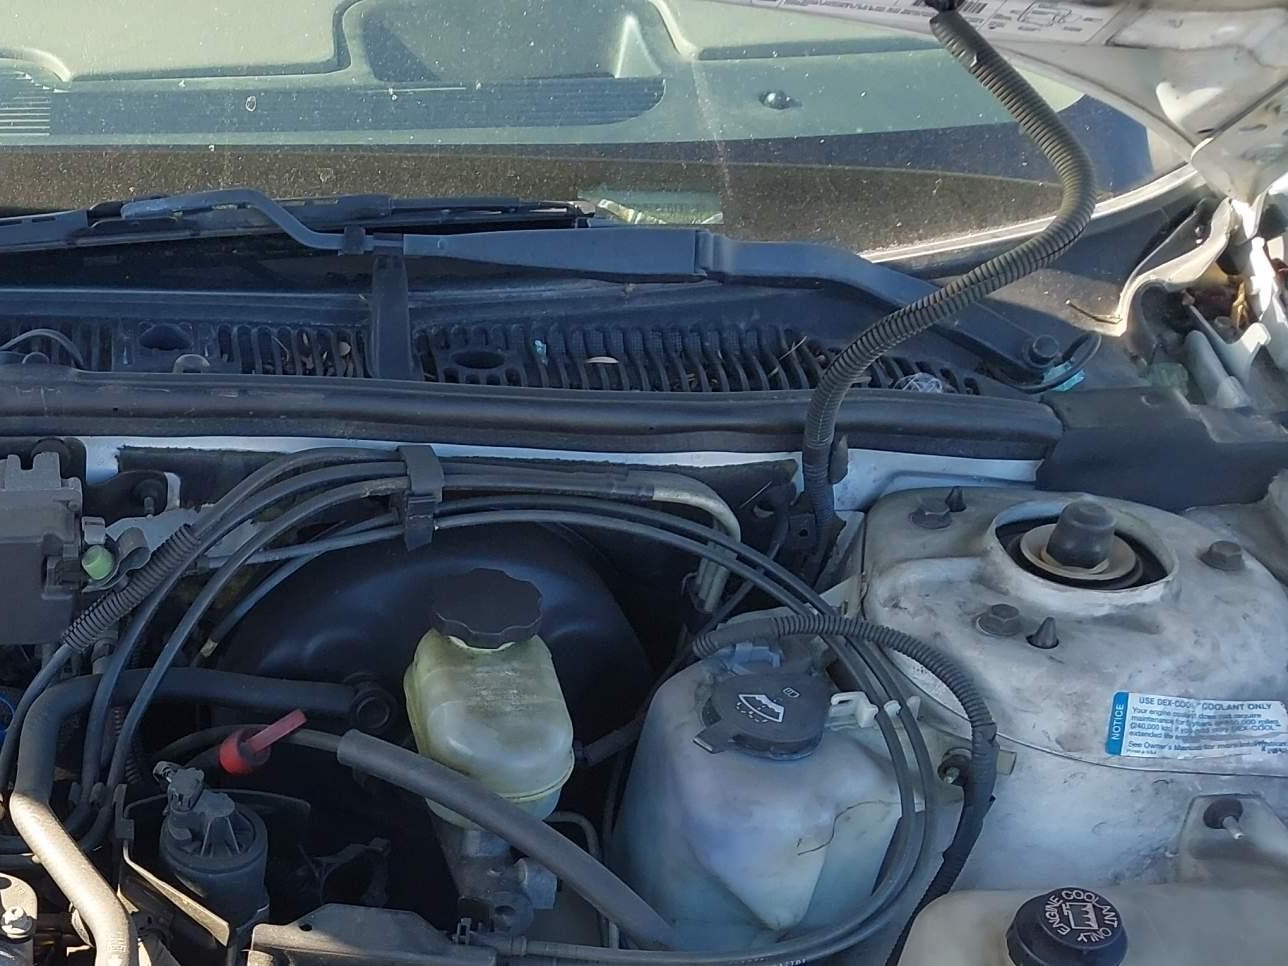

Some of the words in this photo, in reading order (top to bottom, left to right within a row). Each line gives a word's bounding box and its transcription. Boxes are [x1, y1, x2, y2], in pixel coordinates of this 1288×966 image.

[1112, 703, 1124, 740] NOTICE
[1139, 697, 1155, 705] USE
[1202, 703, 1244, 711] COOLANT
[1045, 895, 1071, 935] ENGINE
[1062, 890, 1118, 928] COOLANT
[1077, 927, 1112, 942] ONLY
